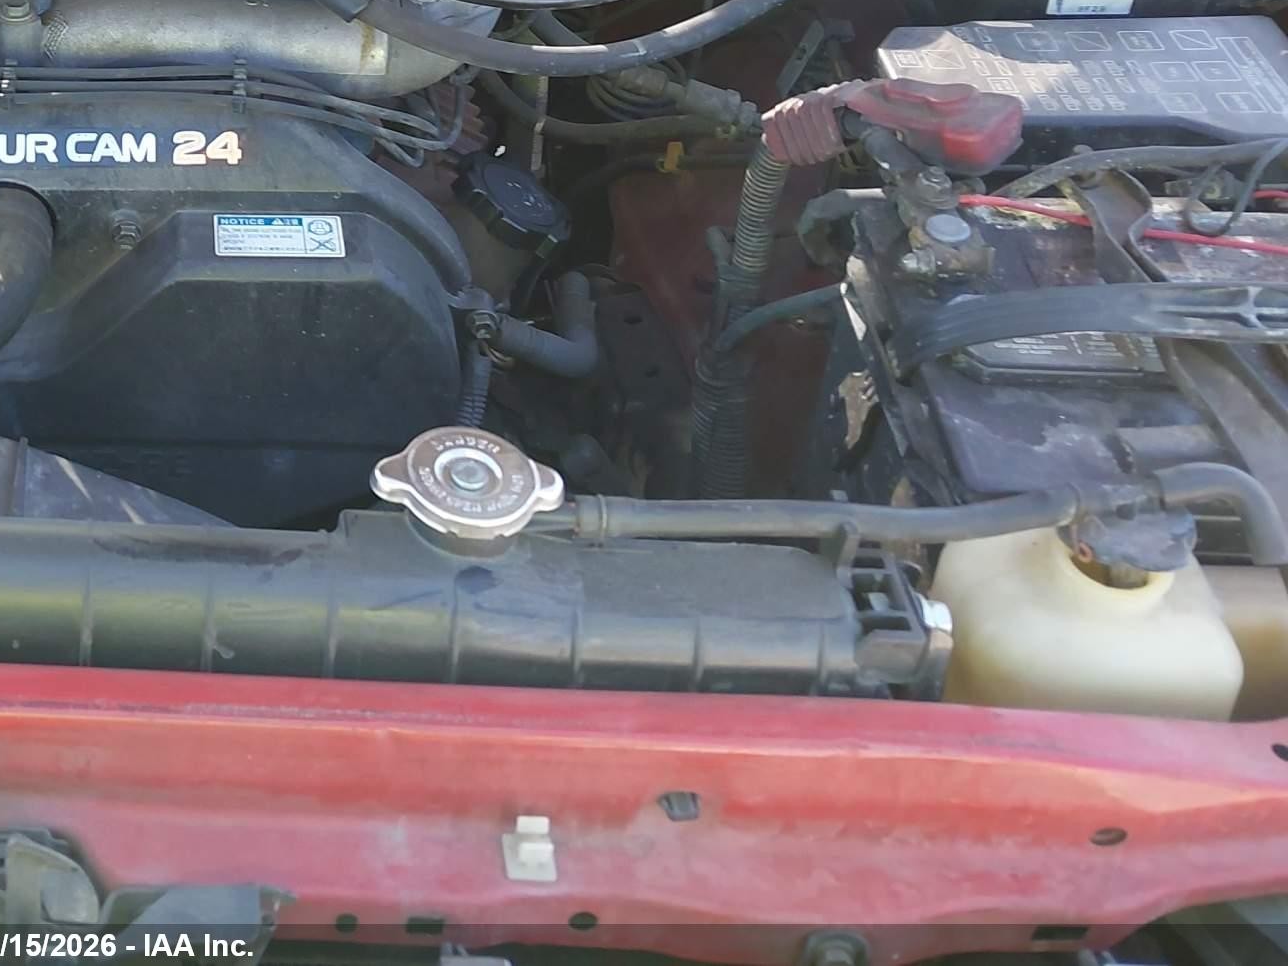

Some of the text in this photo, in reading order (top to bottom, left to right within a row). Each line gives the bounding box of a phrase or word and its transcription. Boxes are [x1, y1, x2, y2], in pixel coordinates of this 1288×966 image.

[65, 132, 157, 163] CAM
[172, 130, 243, 166] 24
[219, 218, 265, 226] NOTICE
